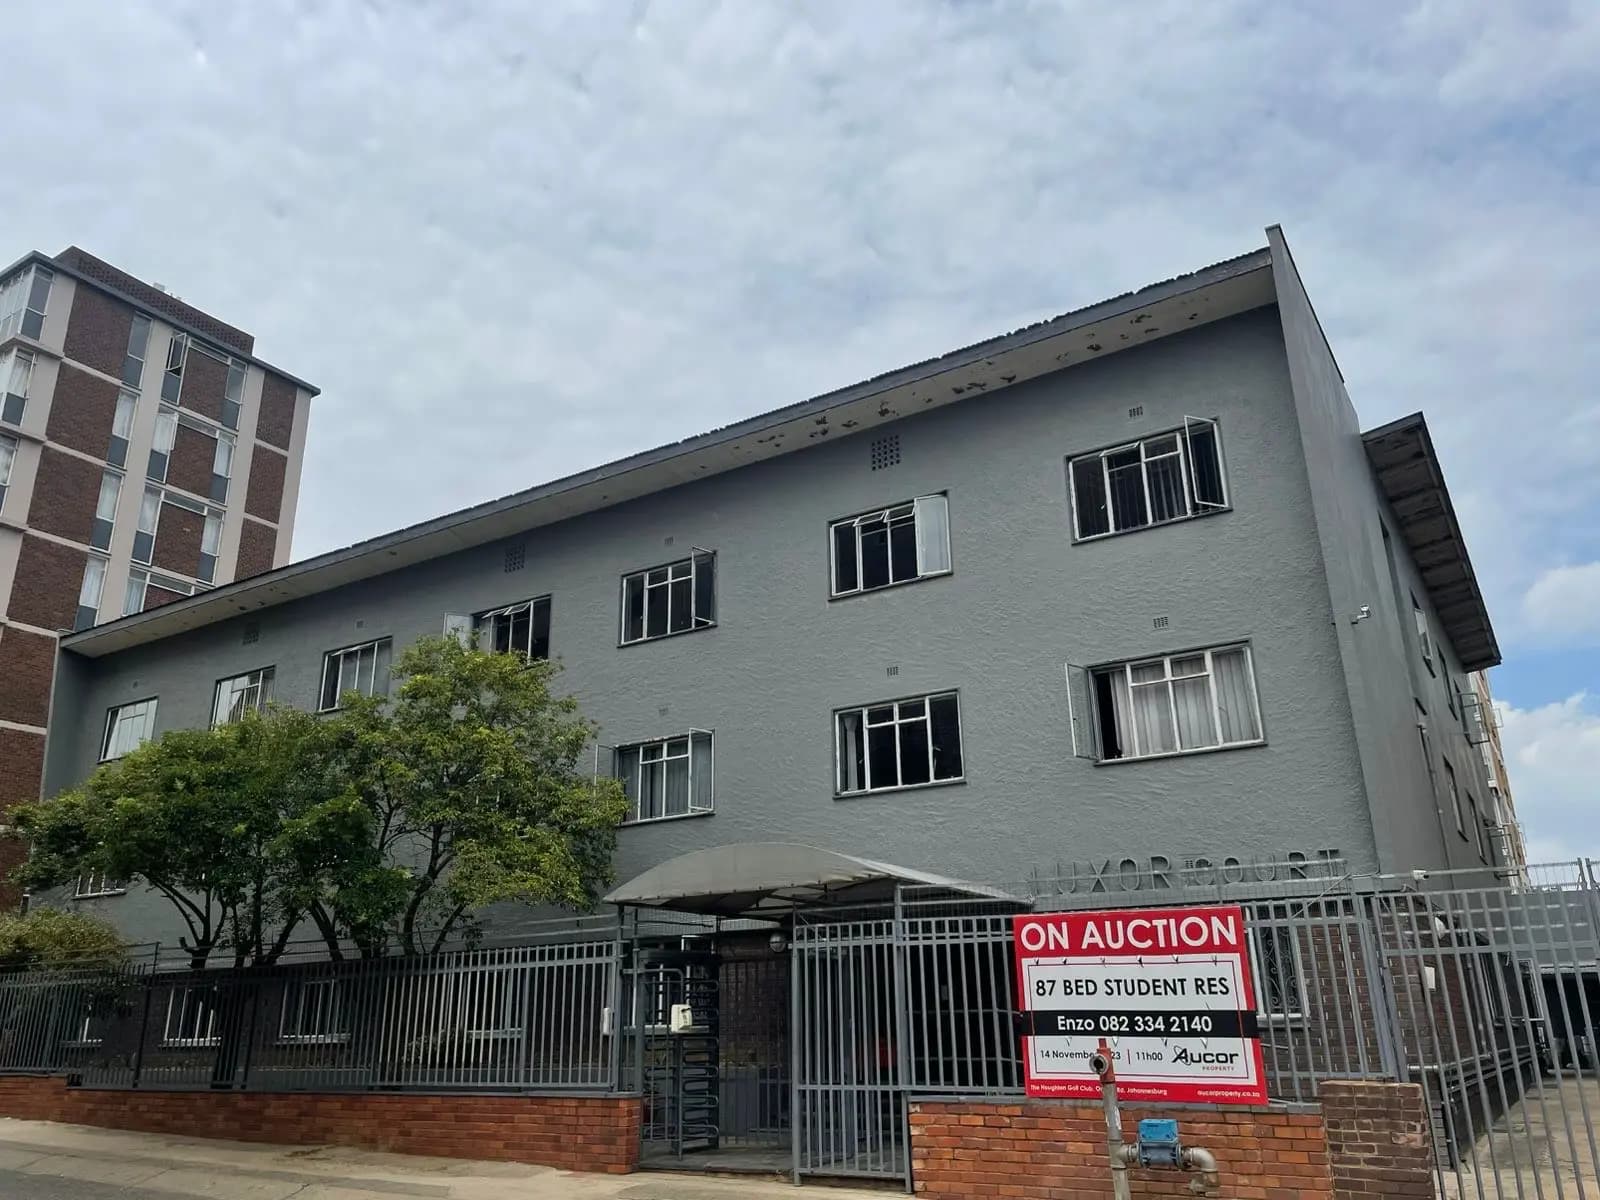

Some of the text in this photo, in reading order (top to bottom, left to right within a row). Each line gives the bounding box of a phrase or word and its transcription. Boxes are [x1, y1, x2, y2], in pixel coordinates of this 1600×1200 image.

[1194, 848, 1340, 886] COURT
[1020, 916, 1237, 950] ON AUCTION
[1035, 977, 1230, 996] 87 BED STUDENT RES
[1057, 1015, 1213, 1032] Enzo 082 334 2140
[1040, 1050, 1050, 1059] 14
[1052, 1050, 1096, 1060] Novembe
[1135, 1052, 1163, 1061] 11h00
[1172, 1046, 1239, 1065] Aucor
